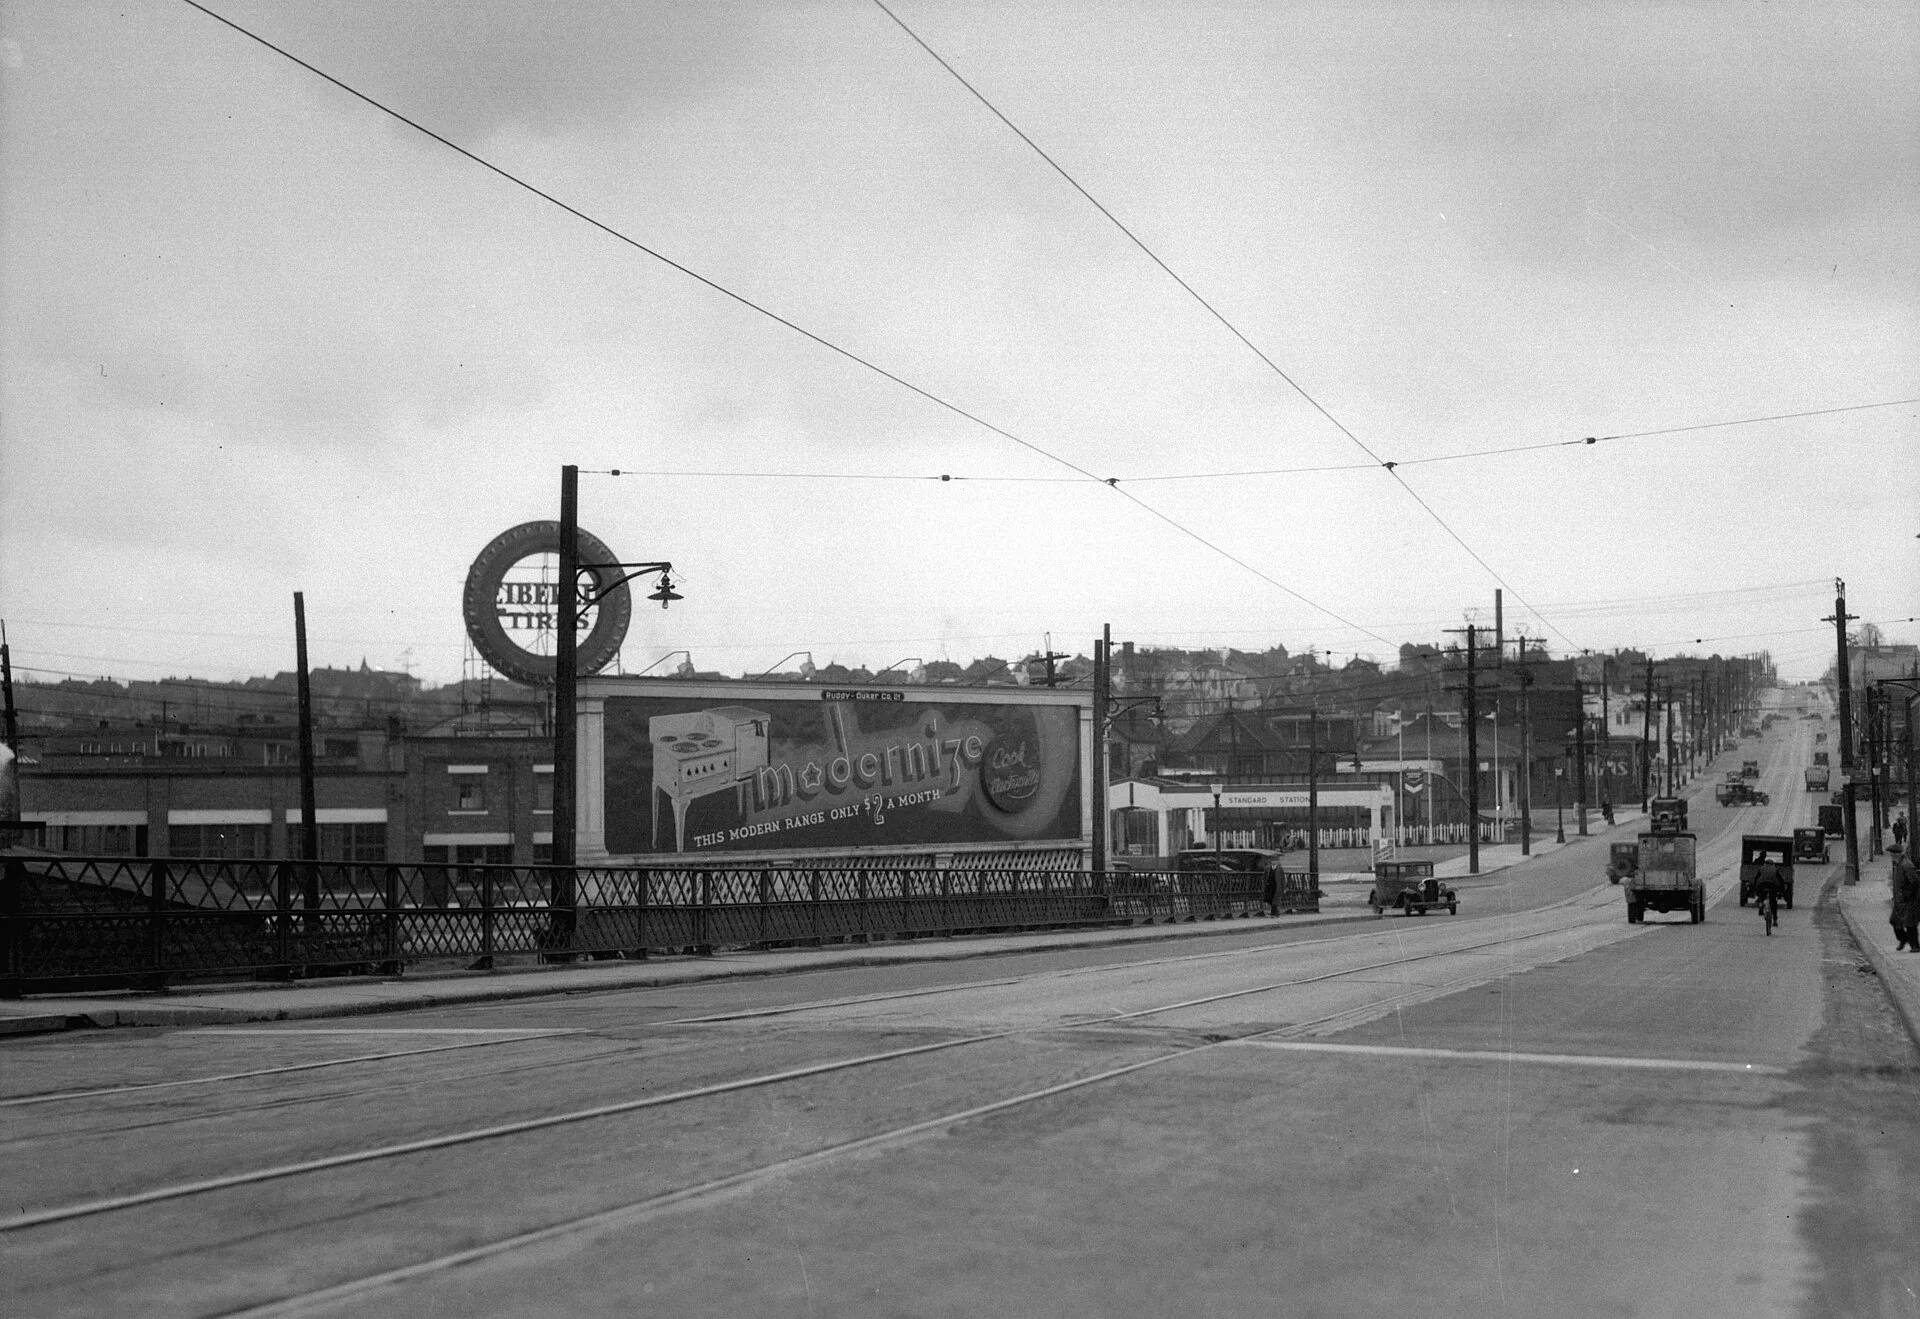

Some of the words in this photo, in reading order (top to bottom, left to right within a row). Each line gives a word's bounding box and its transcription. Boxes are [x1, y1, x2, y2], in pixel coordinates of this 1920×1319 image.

[508, 611, 589, 630] TIRS
[1229, 796, 1268, 804] STANDARD
[1280, 796, 1311, 804] STATION
[694, 832, 725, 847] THIS
[729, 821, 781, 841] MODERN
[785, 811, 826, 830] RANGE
[830, 804, 861, 821] ONLY
[887, 798, 896, 810] A
[899, 788, 941, 807] MONTH
